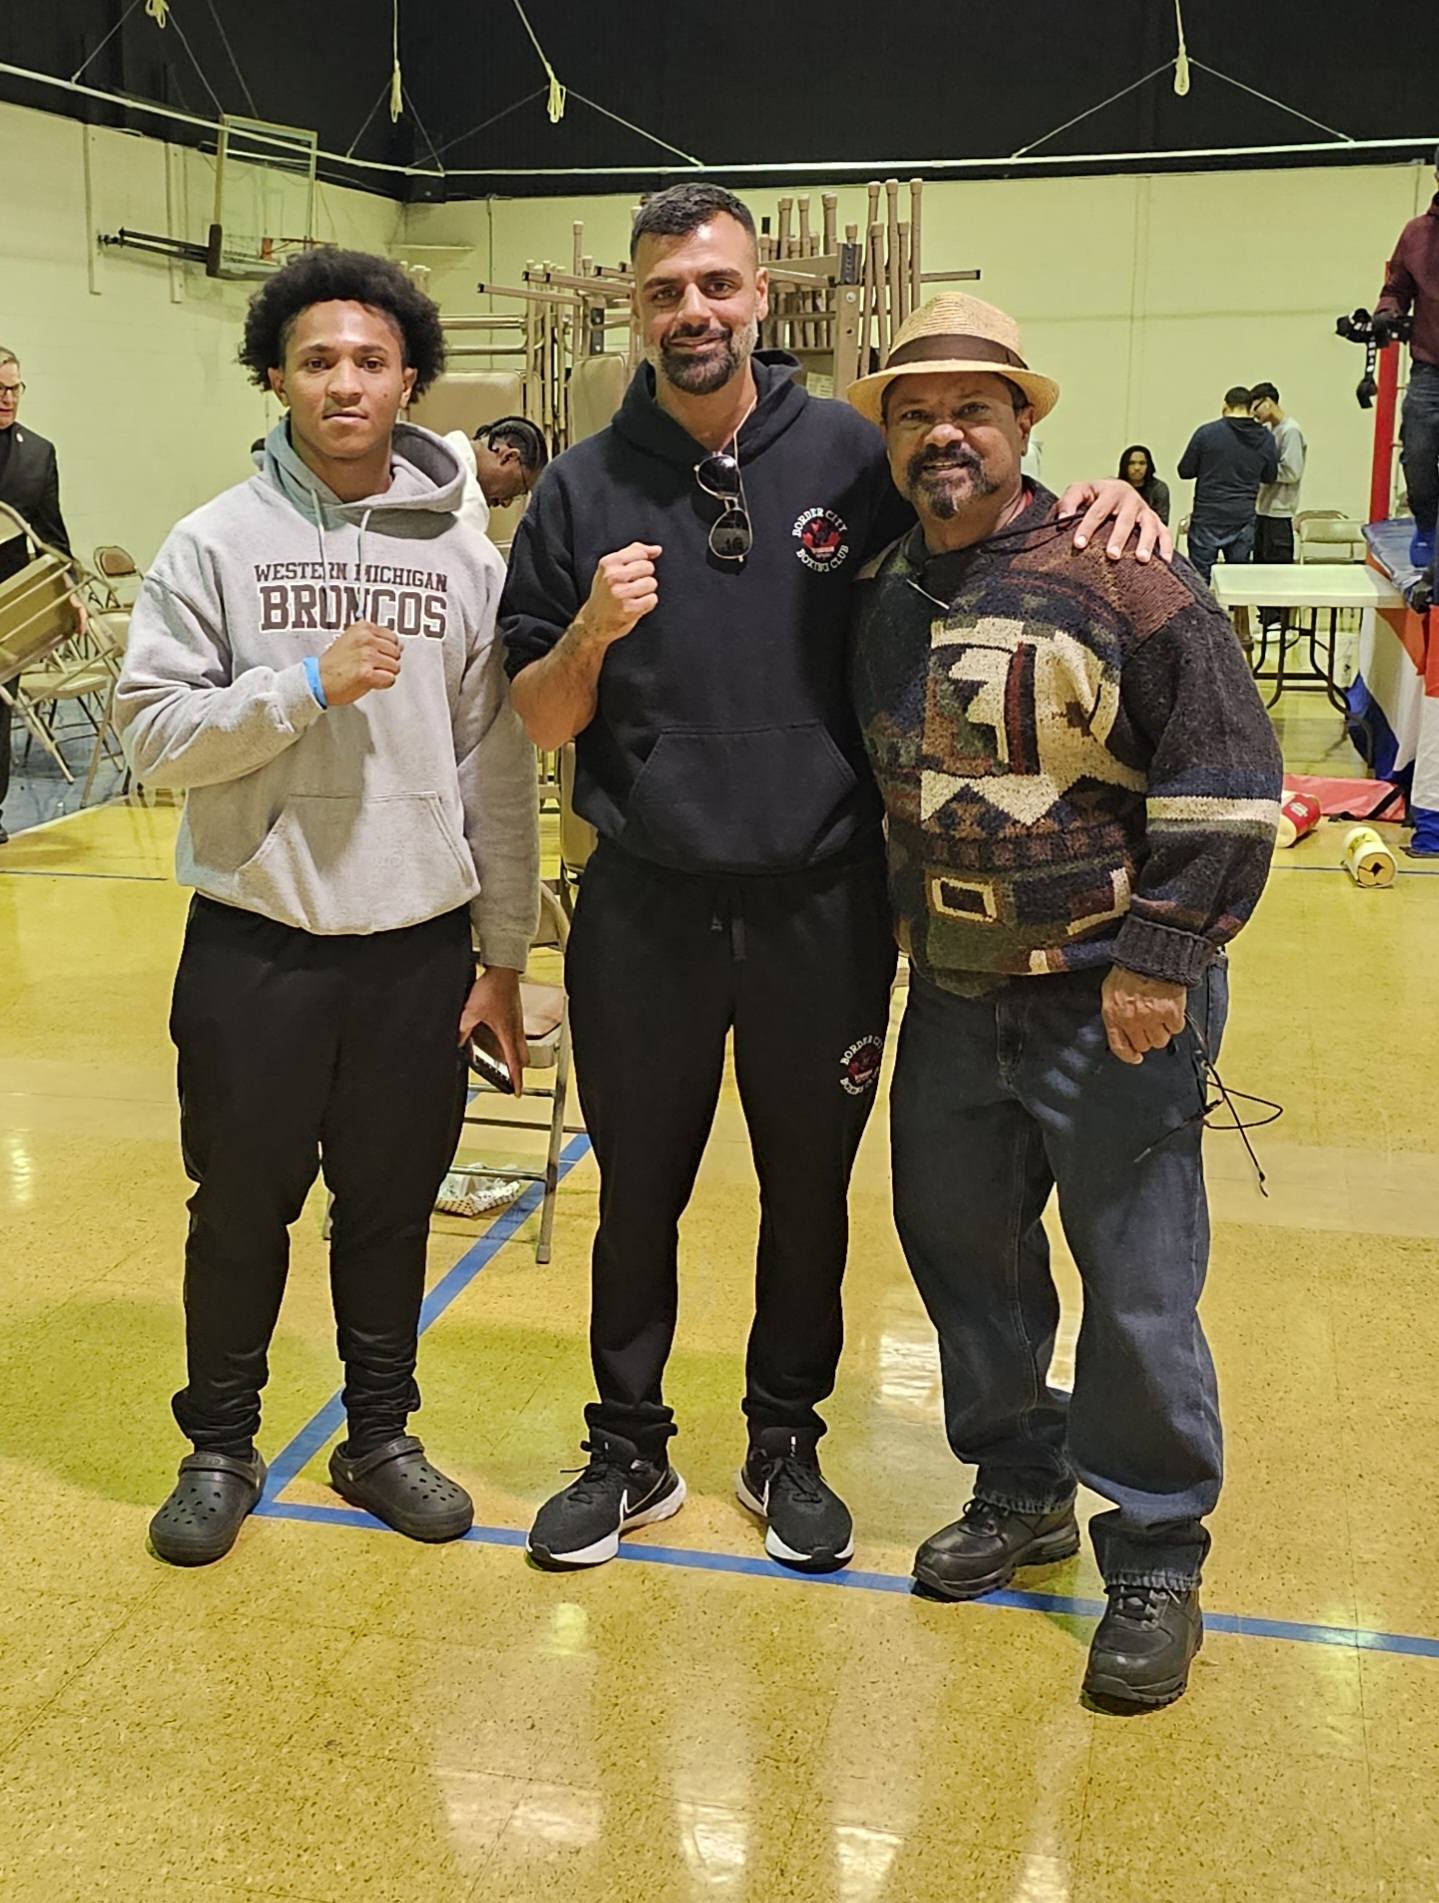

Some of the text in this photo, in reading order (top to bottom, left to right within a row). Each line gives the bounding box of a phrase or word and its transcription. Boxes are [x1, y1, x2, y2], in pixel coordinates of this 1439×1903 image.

[792, 507, 848, 538] BORDER CITY
[795, 545, 849, 572] BOXING CLUB
[254, 562, 448, 592] WESTERN MICHIGAN
[259, 583, 448, 640] BRONCOS
